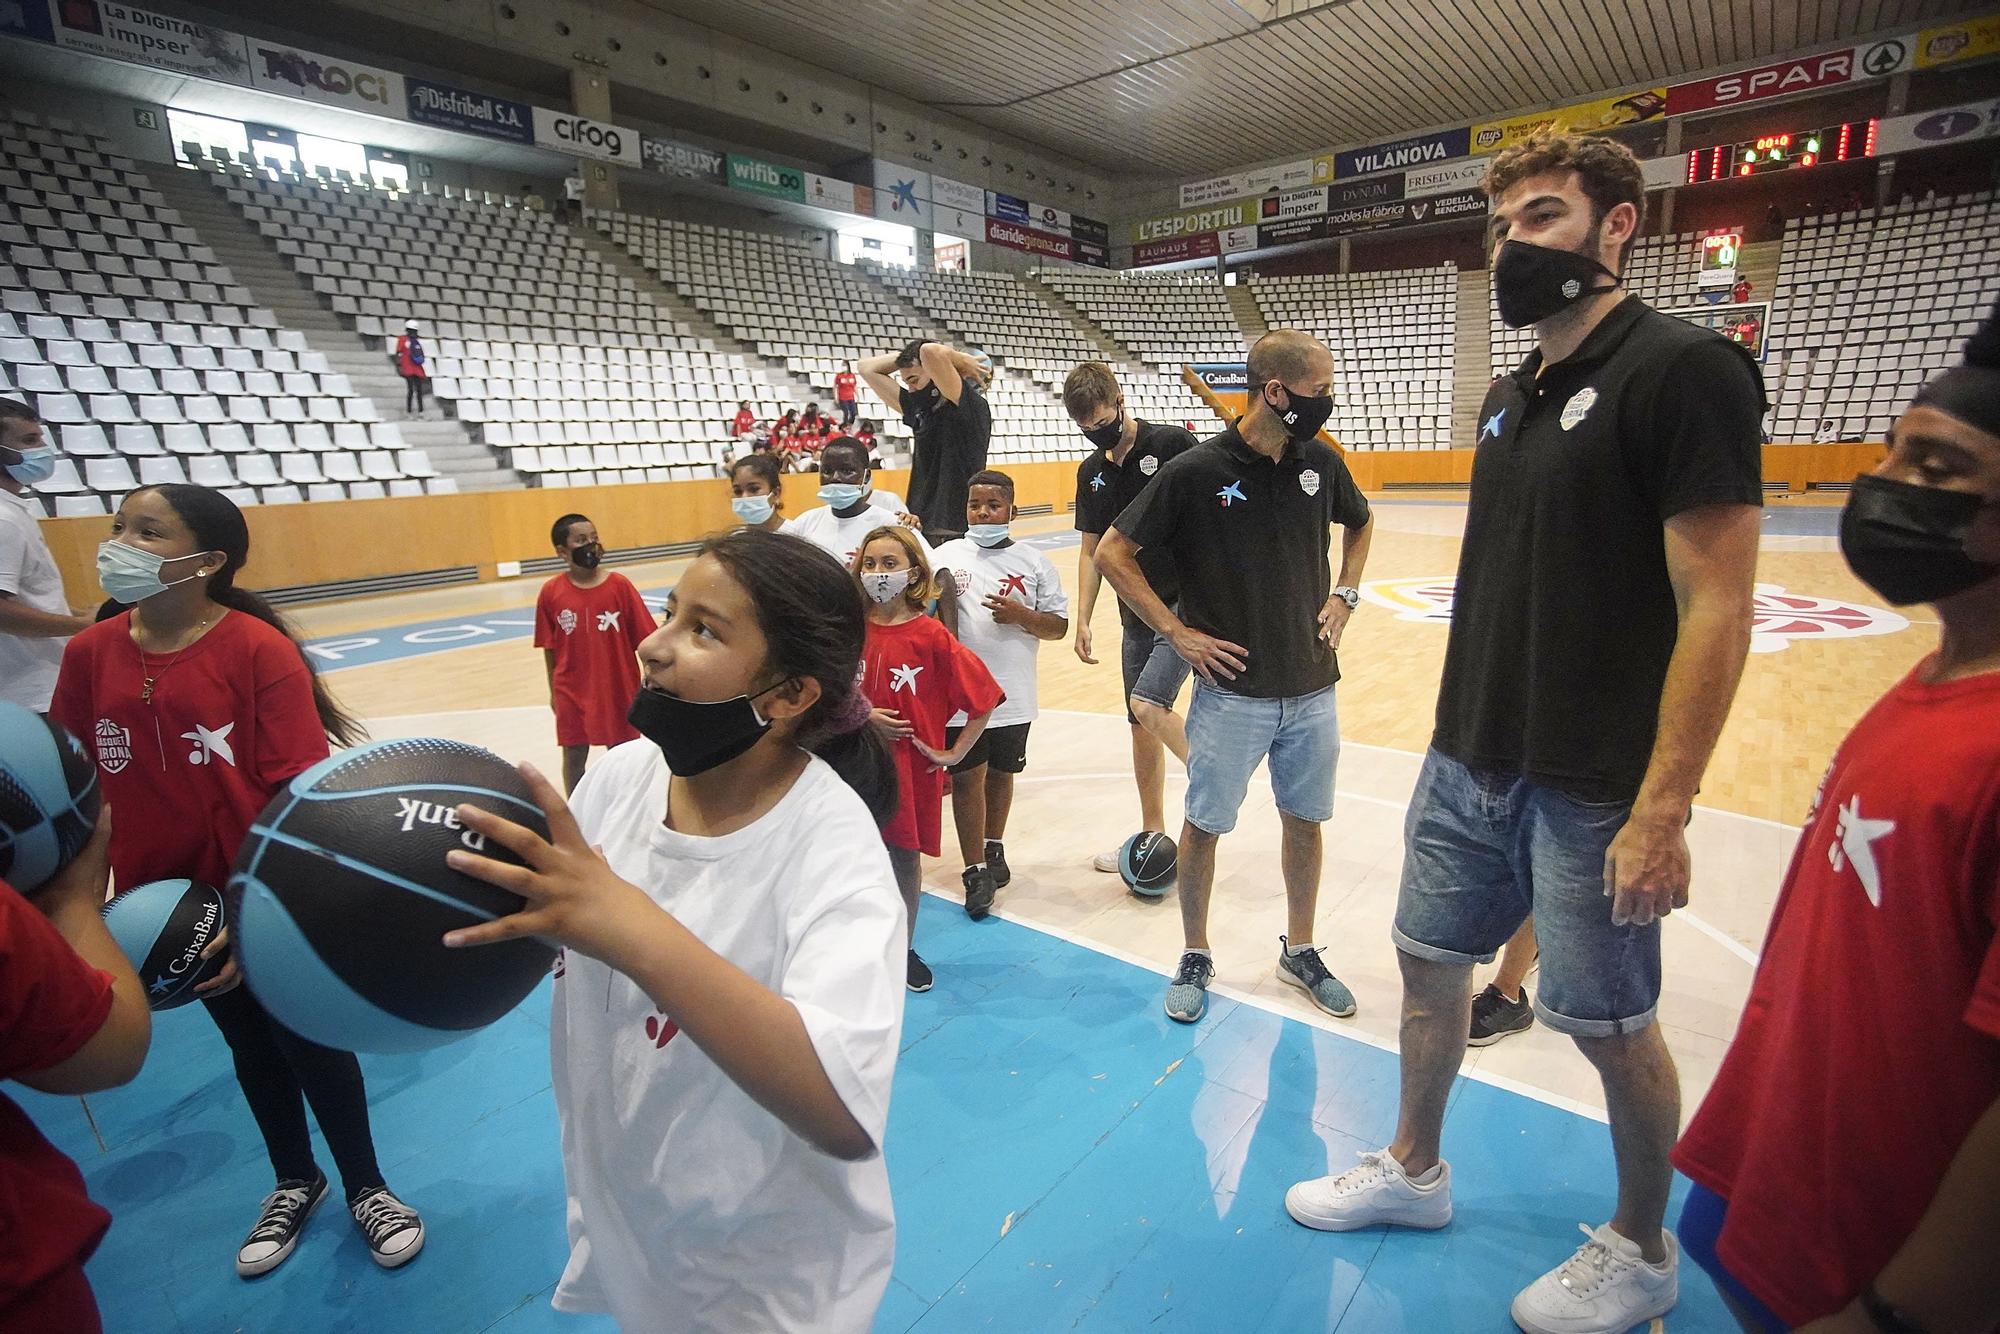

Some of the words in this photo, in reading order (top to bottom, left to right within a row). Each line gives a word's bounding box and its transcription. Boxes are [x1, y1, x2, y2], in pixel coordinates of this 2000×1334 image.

[104, 3, 126, 20] La
[131, 11, 204, 39] DIGITAL
[108, 22, 191, 55] impser
[1714, 55, 1850, 101] SPAR
[1354, 141, 1447, 173] VILANOVA
[1408, 170, 1458, 188] FRISELVA
[1292, 189, 1323, 201] DIGITAL
[1434, 194, 1474, 208] VEDELLA
[1281, 202, 1320, 216] impser
[1327, 208, 1362, 225] mobles
[1363, 207, 1372, 220] la
[1434, 200, 1486, 216] BENCRIADA
[1139, 206, 1243, 241] L'ESPORTIU
[989, 223, 1070, 256] diaridegirona.cat
[1139, 241, 1189, 258] BAUHAUS
[169, 901, 219, 974] CaixaBank
